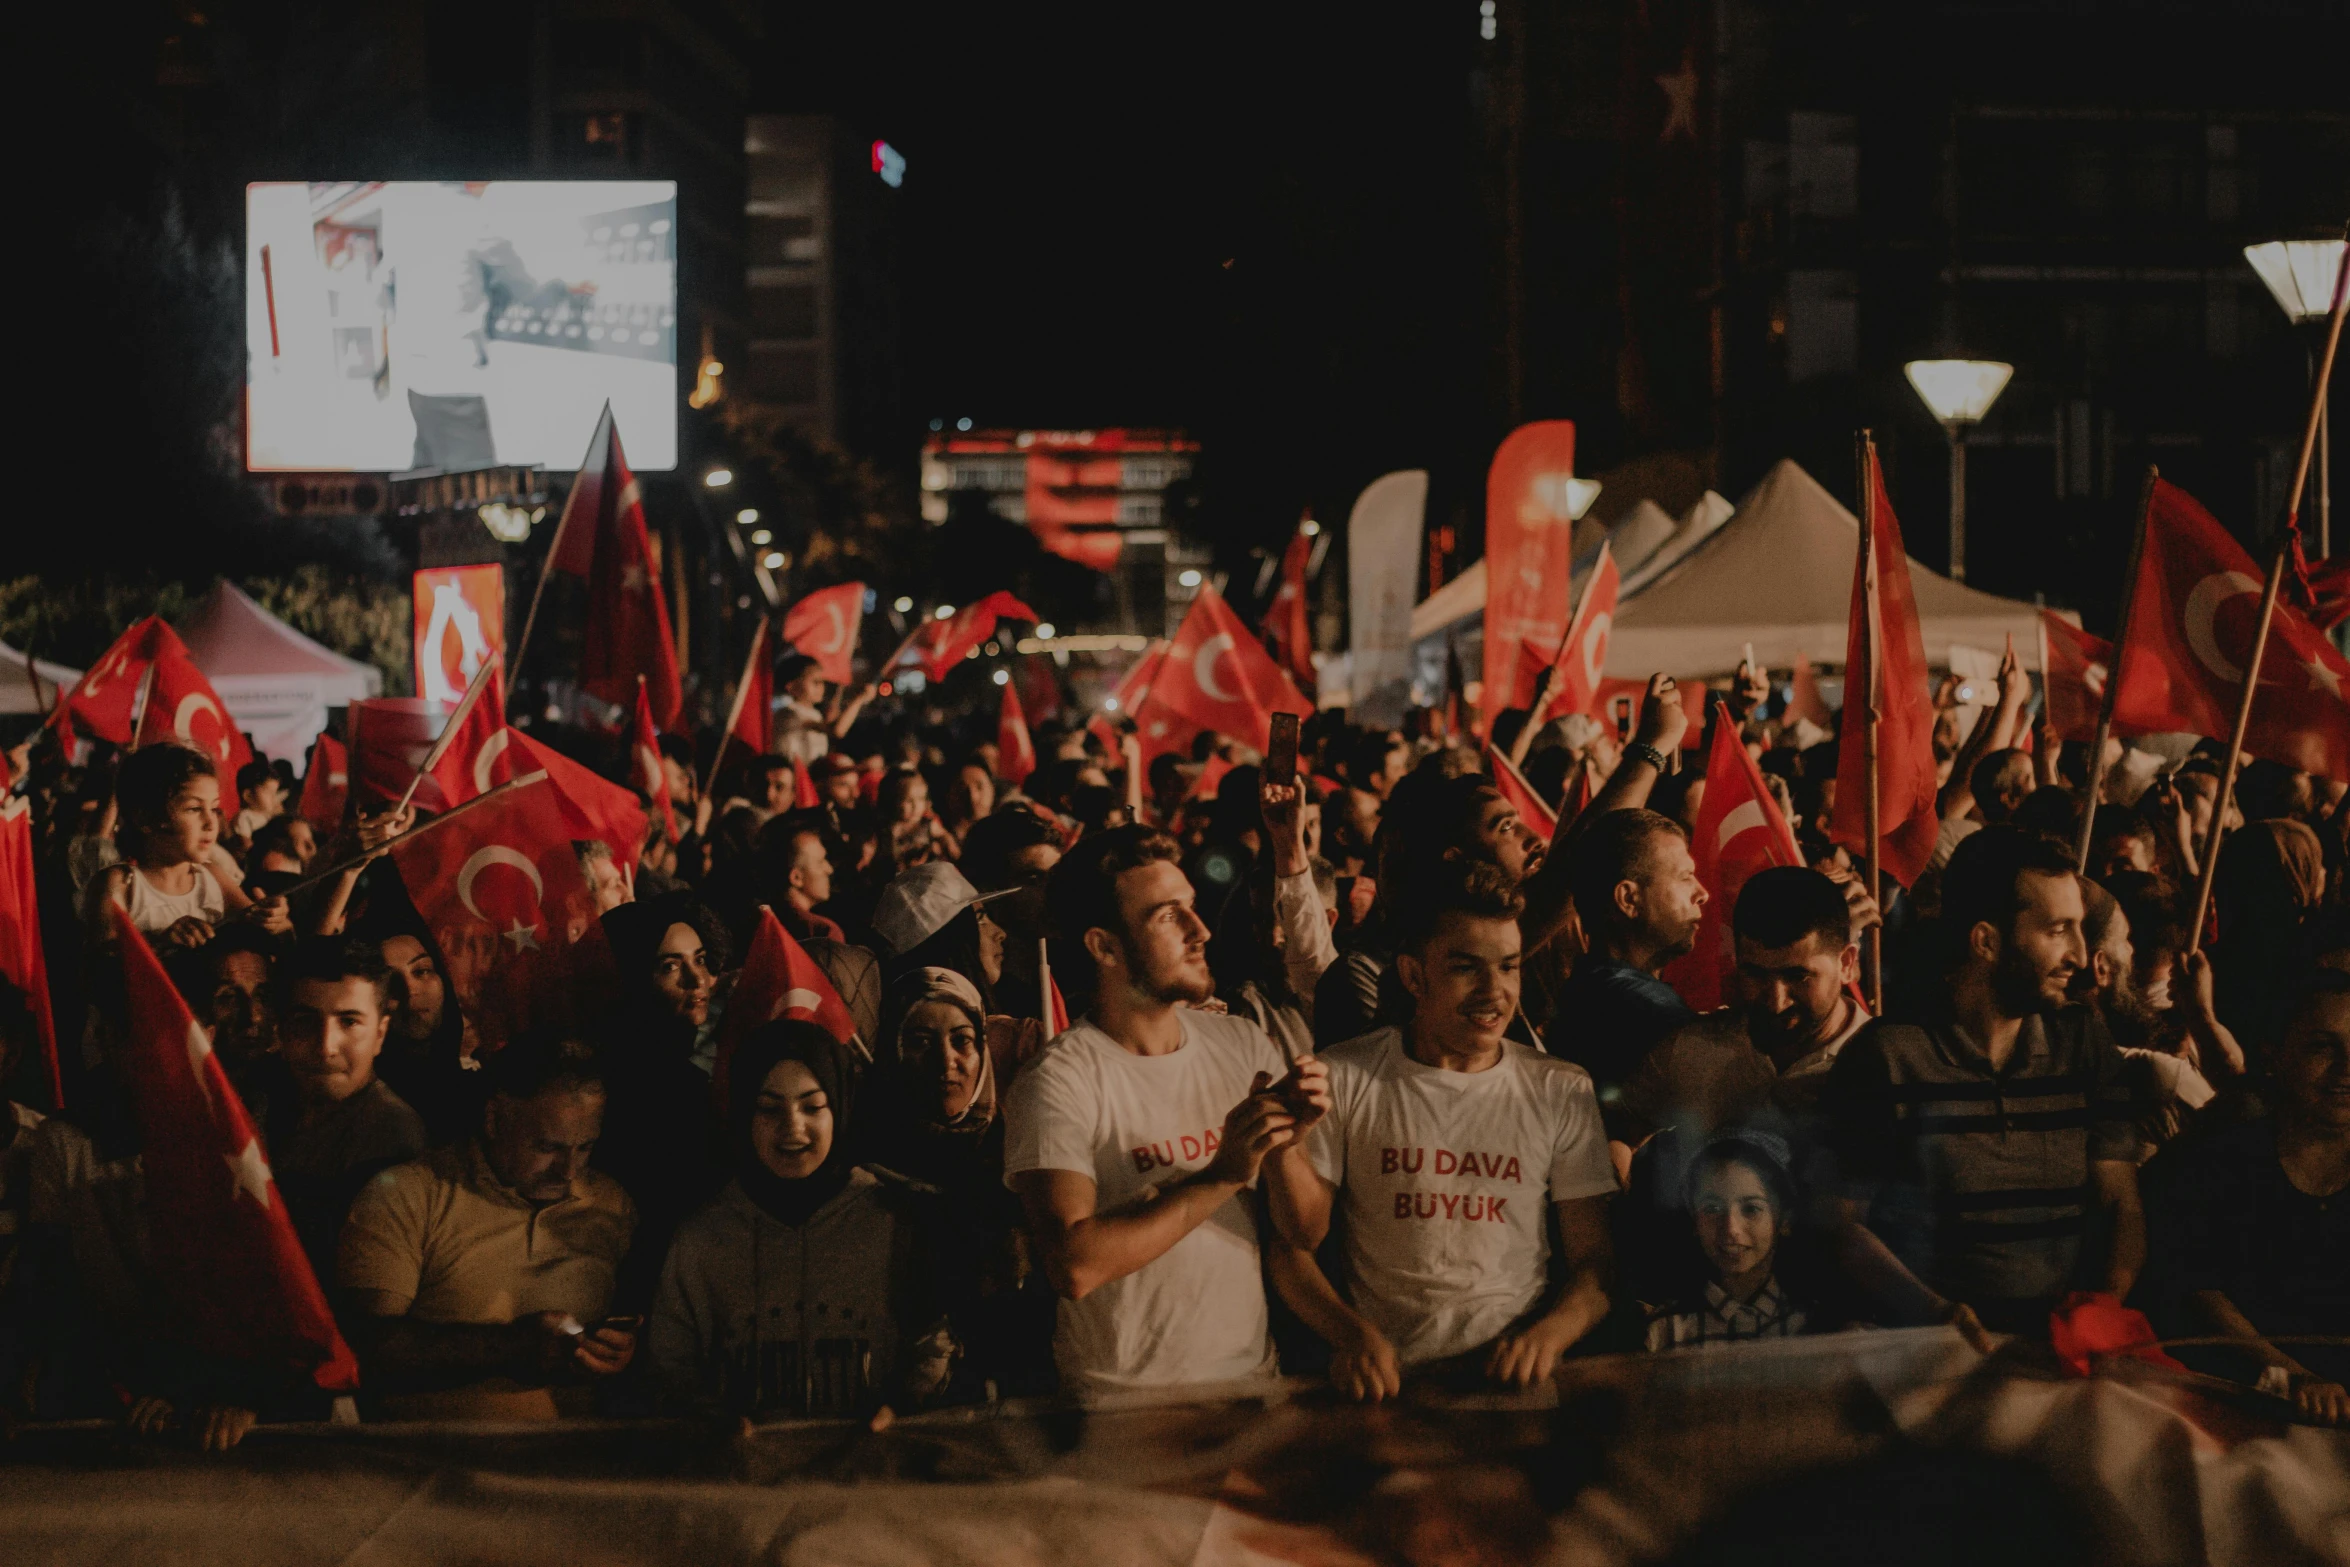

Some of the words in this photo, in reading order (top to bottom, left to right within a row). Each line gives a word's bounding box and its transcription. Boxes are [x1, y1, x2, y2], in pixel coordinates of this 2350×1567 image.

[1131, 1139, 1175, 1174] BU
[1179, 1125, 1226, 1162] DA
[1381, 1147, 1424, 1175] BU
[1434, 1148, 1522, 1184] DAVA
[1393, 1192, 1508, 1224] BÜYÜK
